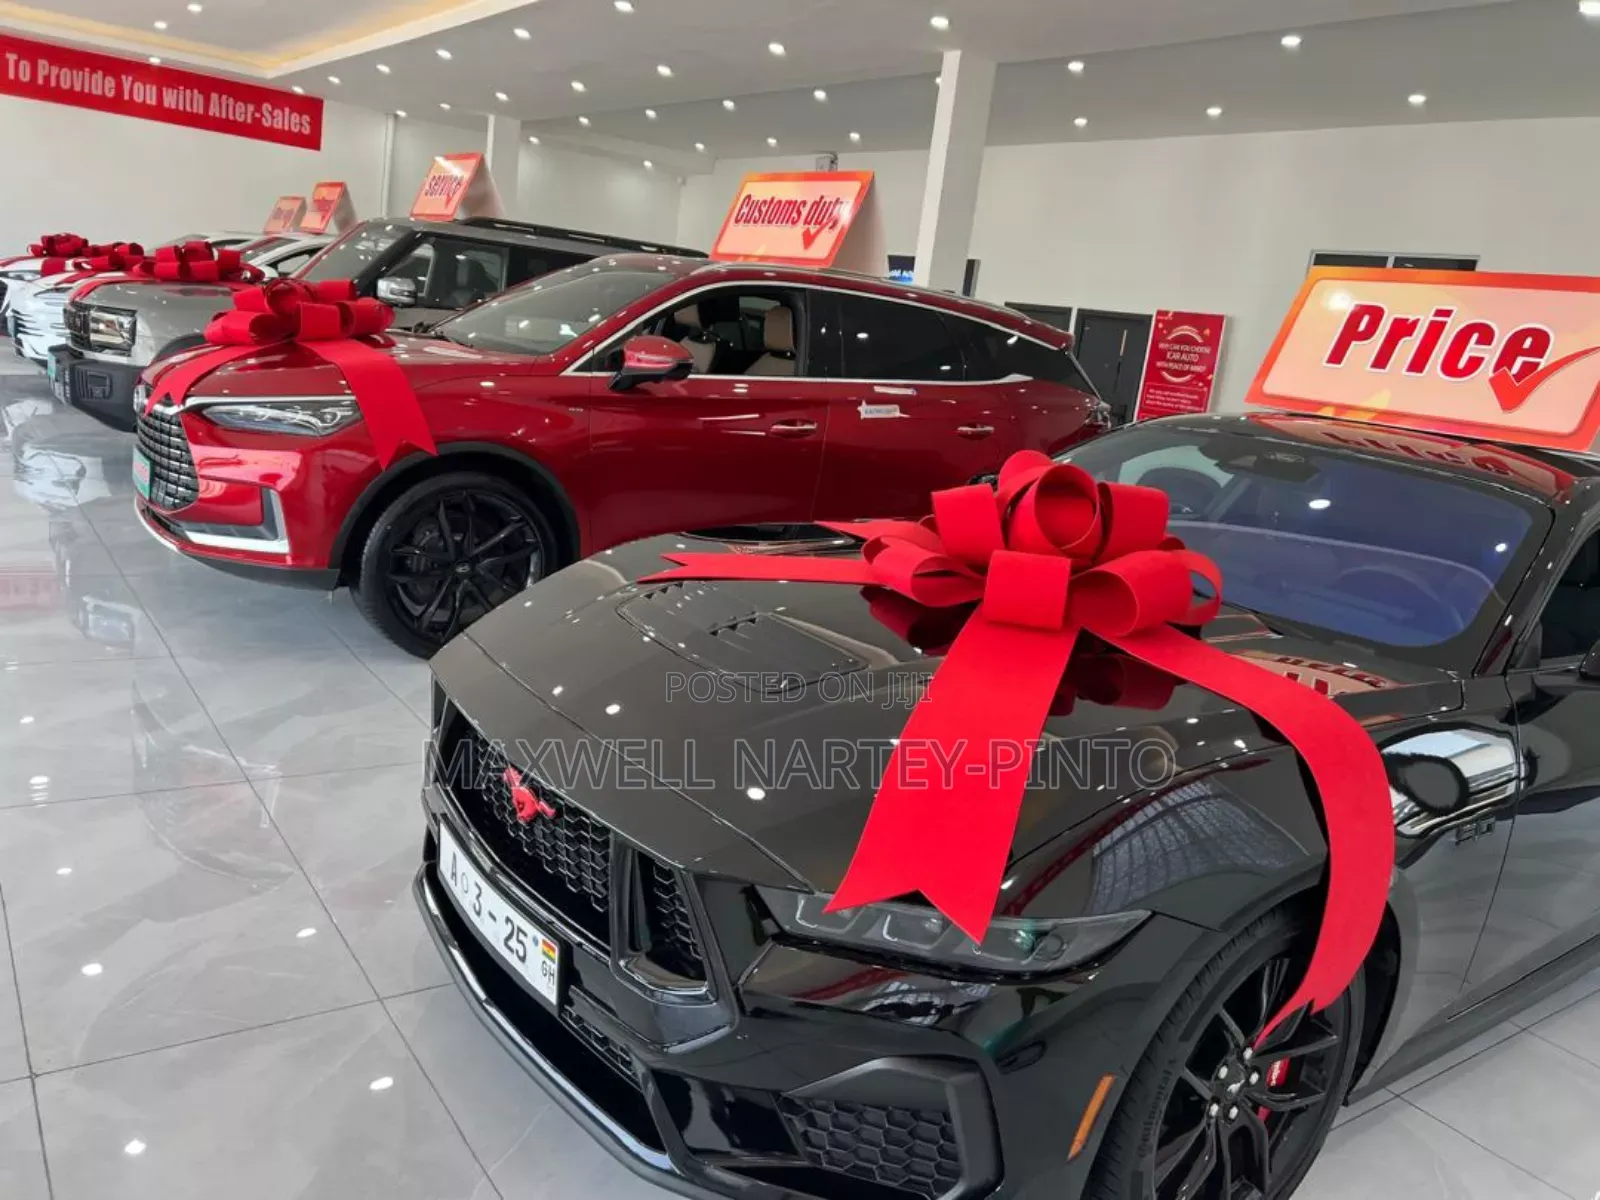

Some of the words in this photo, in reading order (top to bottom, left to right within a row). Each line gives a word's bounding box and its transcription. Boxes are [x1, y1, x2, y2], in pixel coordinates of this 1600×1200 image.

[6, 51, 31, 82] To
[37, 58, 116, 98] Provide
[121, 74, 158, 106] You
[162, 86, 205, 115] with
[208, 91, 311, 135] After-Sales
[735, 194, 807, 226] Customs
[1324, 302, 1552, 383] Price
